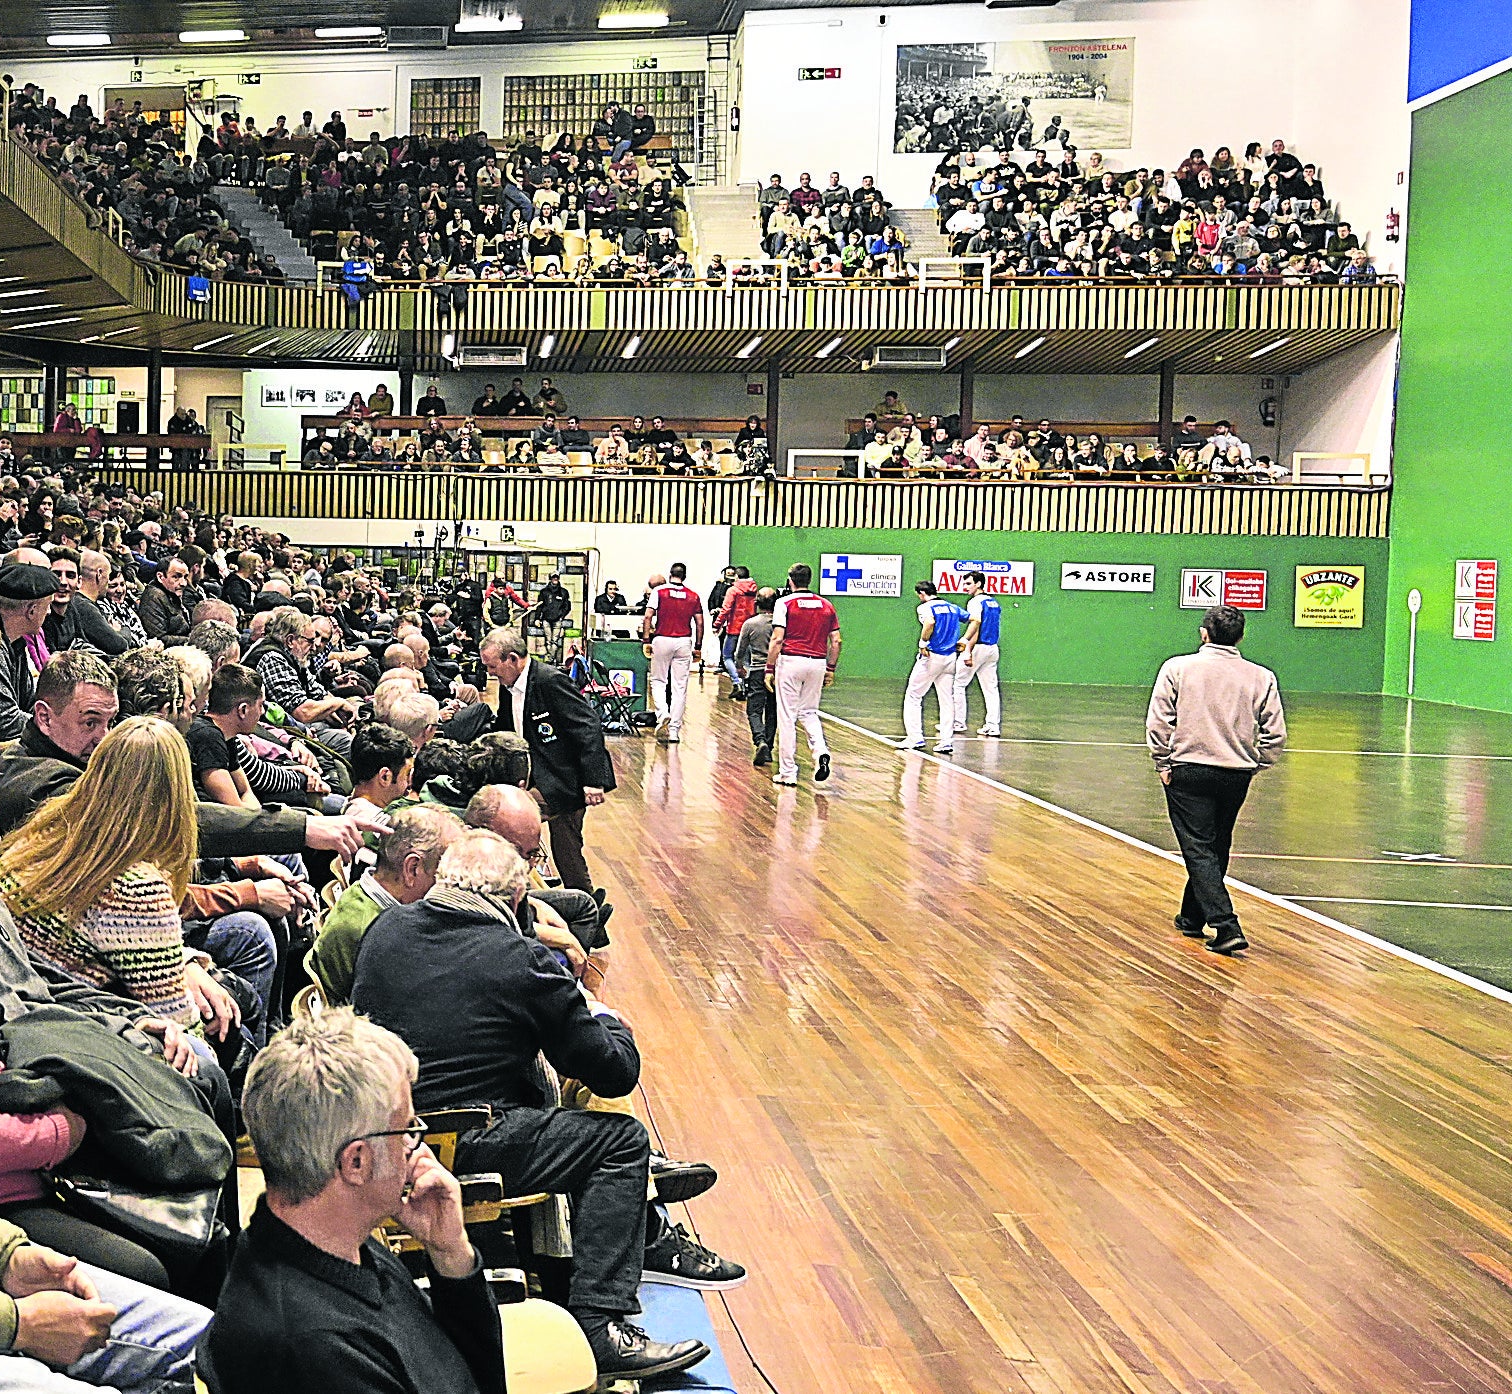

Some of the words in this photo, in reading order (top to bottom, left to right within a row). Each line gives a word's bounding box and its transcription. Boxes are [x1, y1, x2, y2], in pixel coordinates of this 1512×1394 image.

[1087, 44, 1127, 52] ASTELENA
[956, 562, 982, 570] Gallina
[983, 562, 1009, 571] Blanca
[937, 572, 1026, 594] AVREM
[1085, 571, 1152, 583] ASTORE
[1304, 571, 1356, 586] URZANTE
